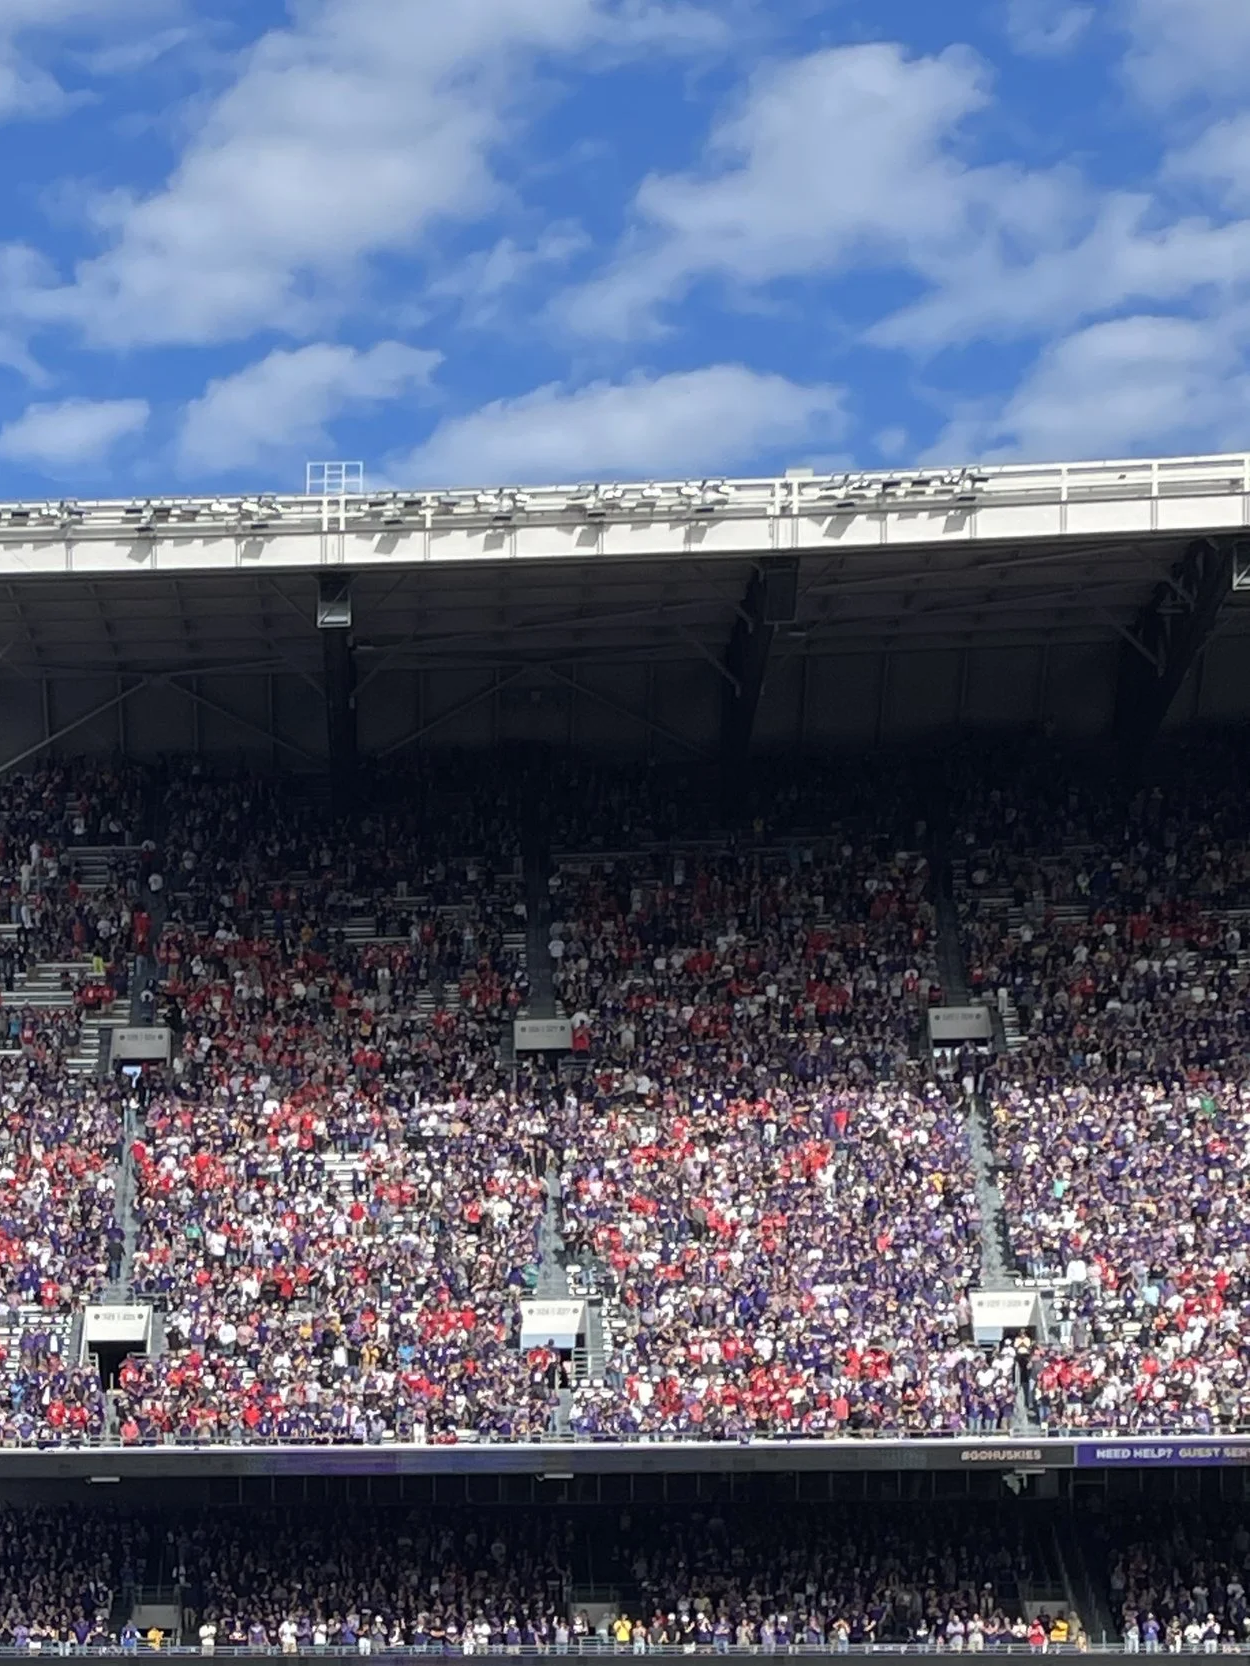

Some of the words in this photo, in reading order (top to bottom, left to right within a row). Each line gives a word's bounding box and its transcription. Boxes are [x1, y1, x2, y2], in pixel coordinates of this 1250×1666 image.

[1096, 1447, 1131, 1459] NEED
[1133, 1447, 1173, 1459] HELP?
[1178, 1447, 1221, 1458] GUEST
